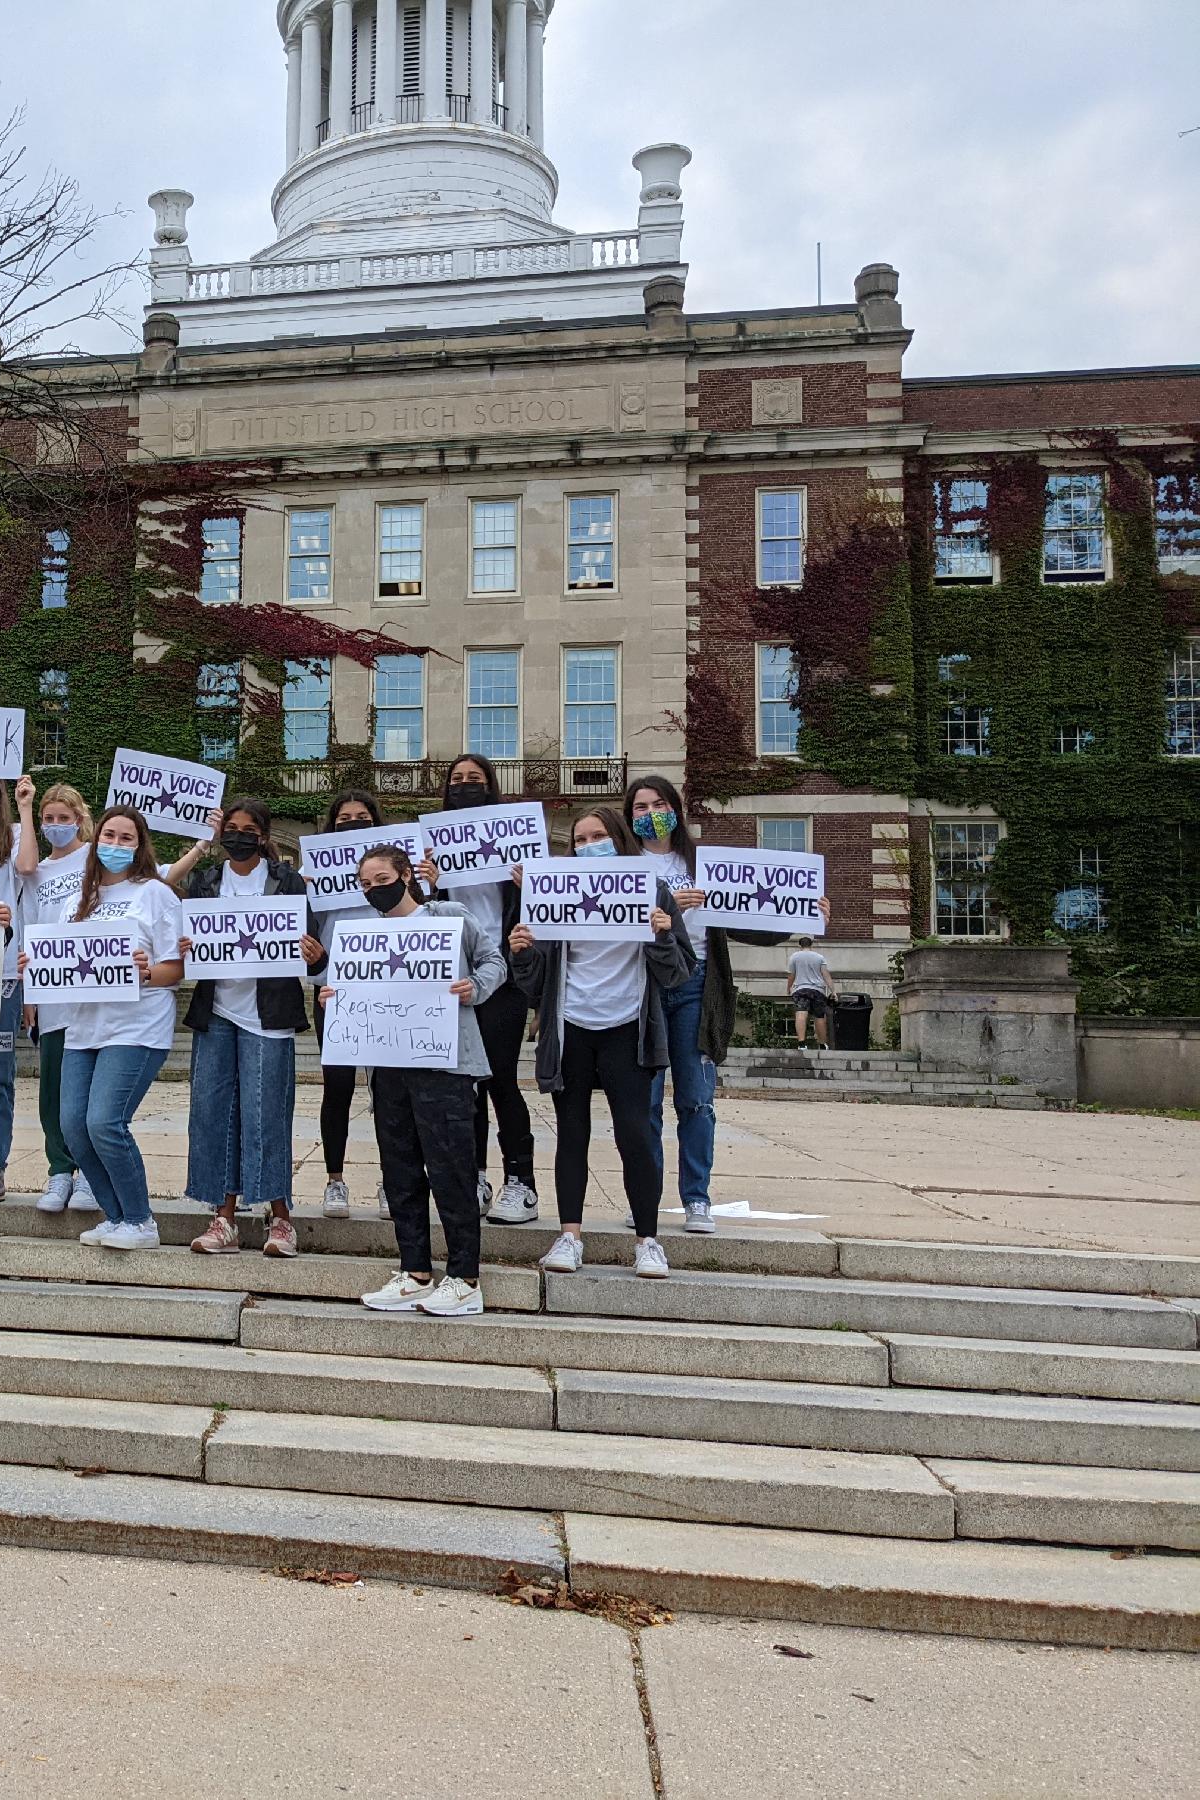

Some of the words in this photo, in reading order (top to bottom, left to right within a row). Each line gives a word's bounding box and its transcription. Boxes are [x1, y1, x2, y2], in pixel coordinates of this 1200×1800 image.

[231, 410, 377, 441] PITTSFIELD
[392, 405, 457, 431] HIGH
[473, 399, 584, 427] SCHOOL
[120, 764, 162, 789] YOUR
[170, 773, 218, 799] VOICE
[113, 788, 155, 813] YOUR
[428, 826, 477, 848] YOUR
[484, 817, 538, 840] VOICE
[309, 847, 356, 869] YOUR
[432, 850, 478, 872] YOUR
[497, 842, 543, 865] VOTE
[311, 873, 359, 896] YOUR
[529, 874, 580, 895] YOUR
[588, 873, 647, 895] VOICE
[703, 863, 755, 885] YOUR
[764, 866, 818, 890] VOICE
[525, 903, 577, 923] YOUR
[599, 903, 650, 924] VOTE
[703, 890, 750, 912] YOUR
[773, 895, 820, 918] VOTE
[189, 914, 237, 935] YOUR
[244, 912, 298, 933] VOICE
[30, 939, 76, 960] YOUR
[83, 937, 131, 958] VOICE
[189, 942, 236, 963] YOUR
[255, 940, 301, 961] VOTE
[339, 934, 388, 953] YOUR
[397, 932, 453, 952] VOICE
[28, 967, 75, 987] YOUR
[92, 964, 134, 986] VOTE
[334, 959, 384, 981] YOUR
[406, 959, 453, 980] VOTE
[334, 988, 417, 1028] Register
[424, 995, 447, 1018] at
[327, 1020, 359, 1056] City
[366, 1023, 400, 1049] Hall
[401, 1027, 452, 1060] Today
